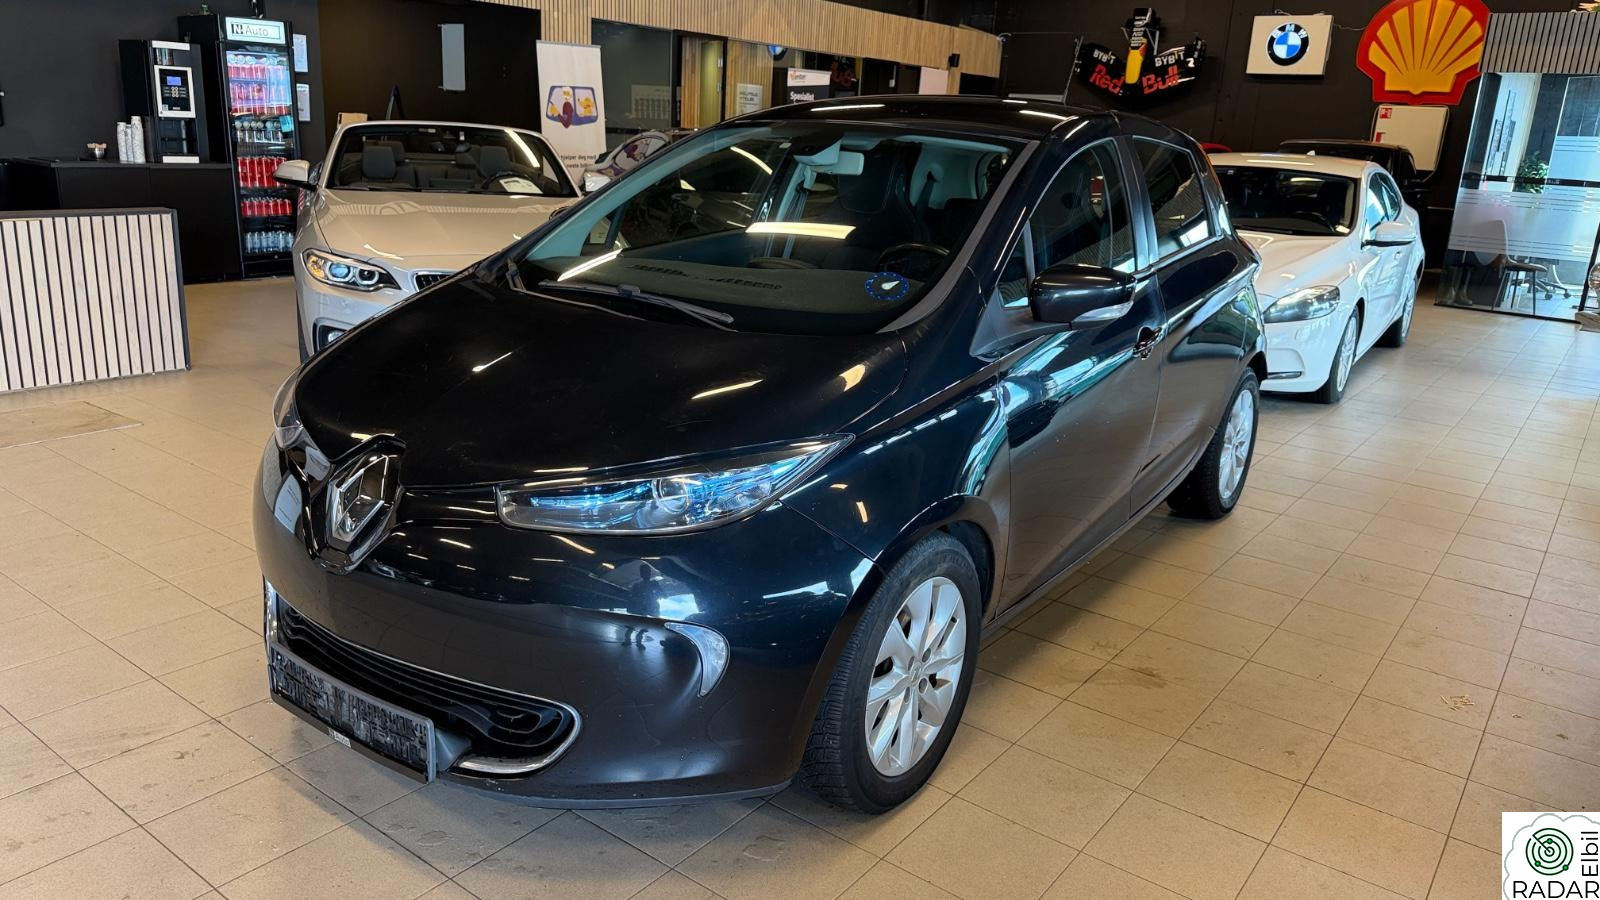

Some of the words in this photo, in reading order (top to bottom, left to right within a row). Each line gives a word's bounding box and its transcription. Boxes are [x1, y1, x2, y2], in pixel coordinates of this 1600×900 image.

[246, 25, 269, 36] Auto
[1271, 23, 1307, 39] BMW
[1093, 49, 1116, 64] BYBIT
[1154, 50, 1185, 67] BYBIT
[1186, 57, 1195, 68] 2
[1089, 64, 1125, 94] Red
[1142, 65, 1180, 94] Bull
